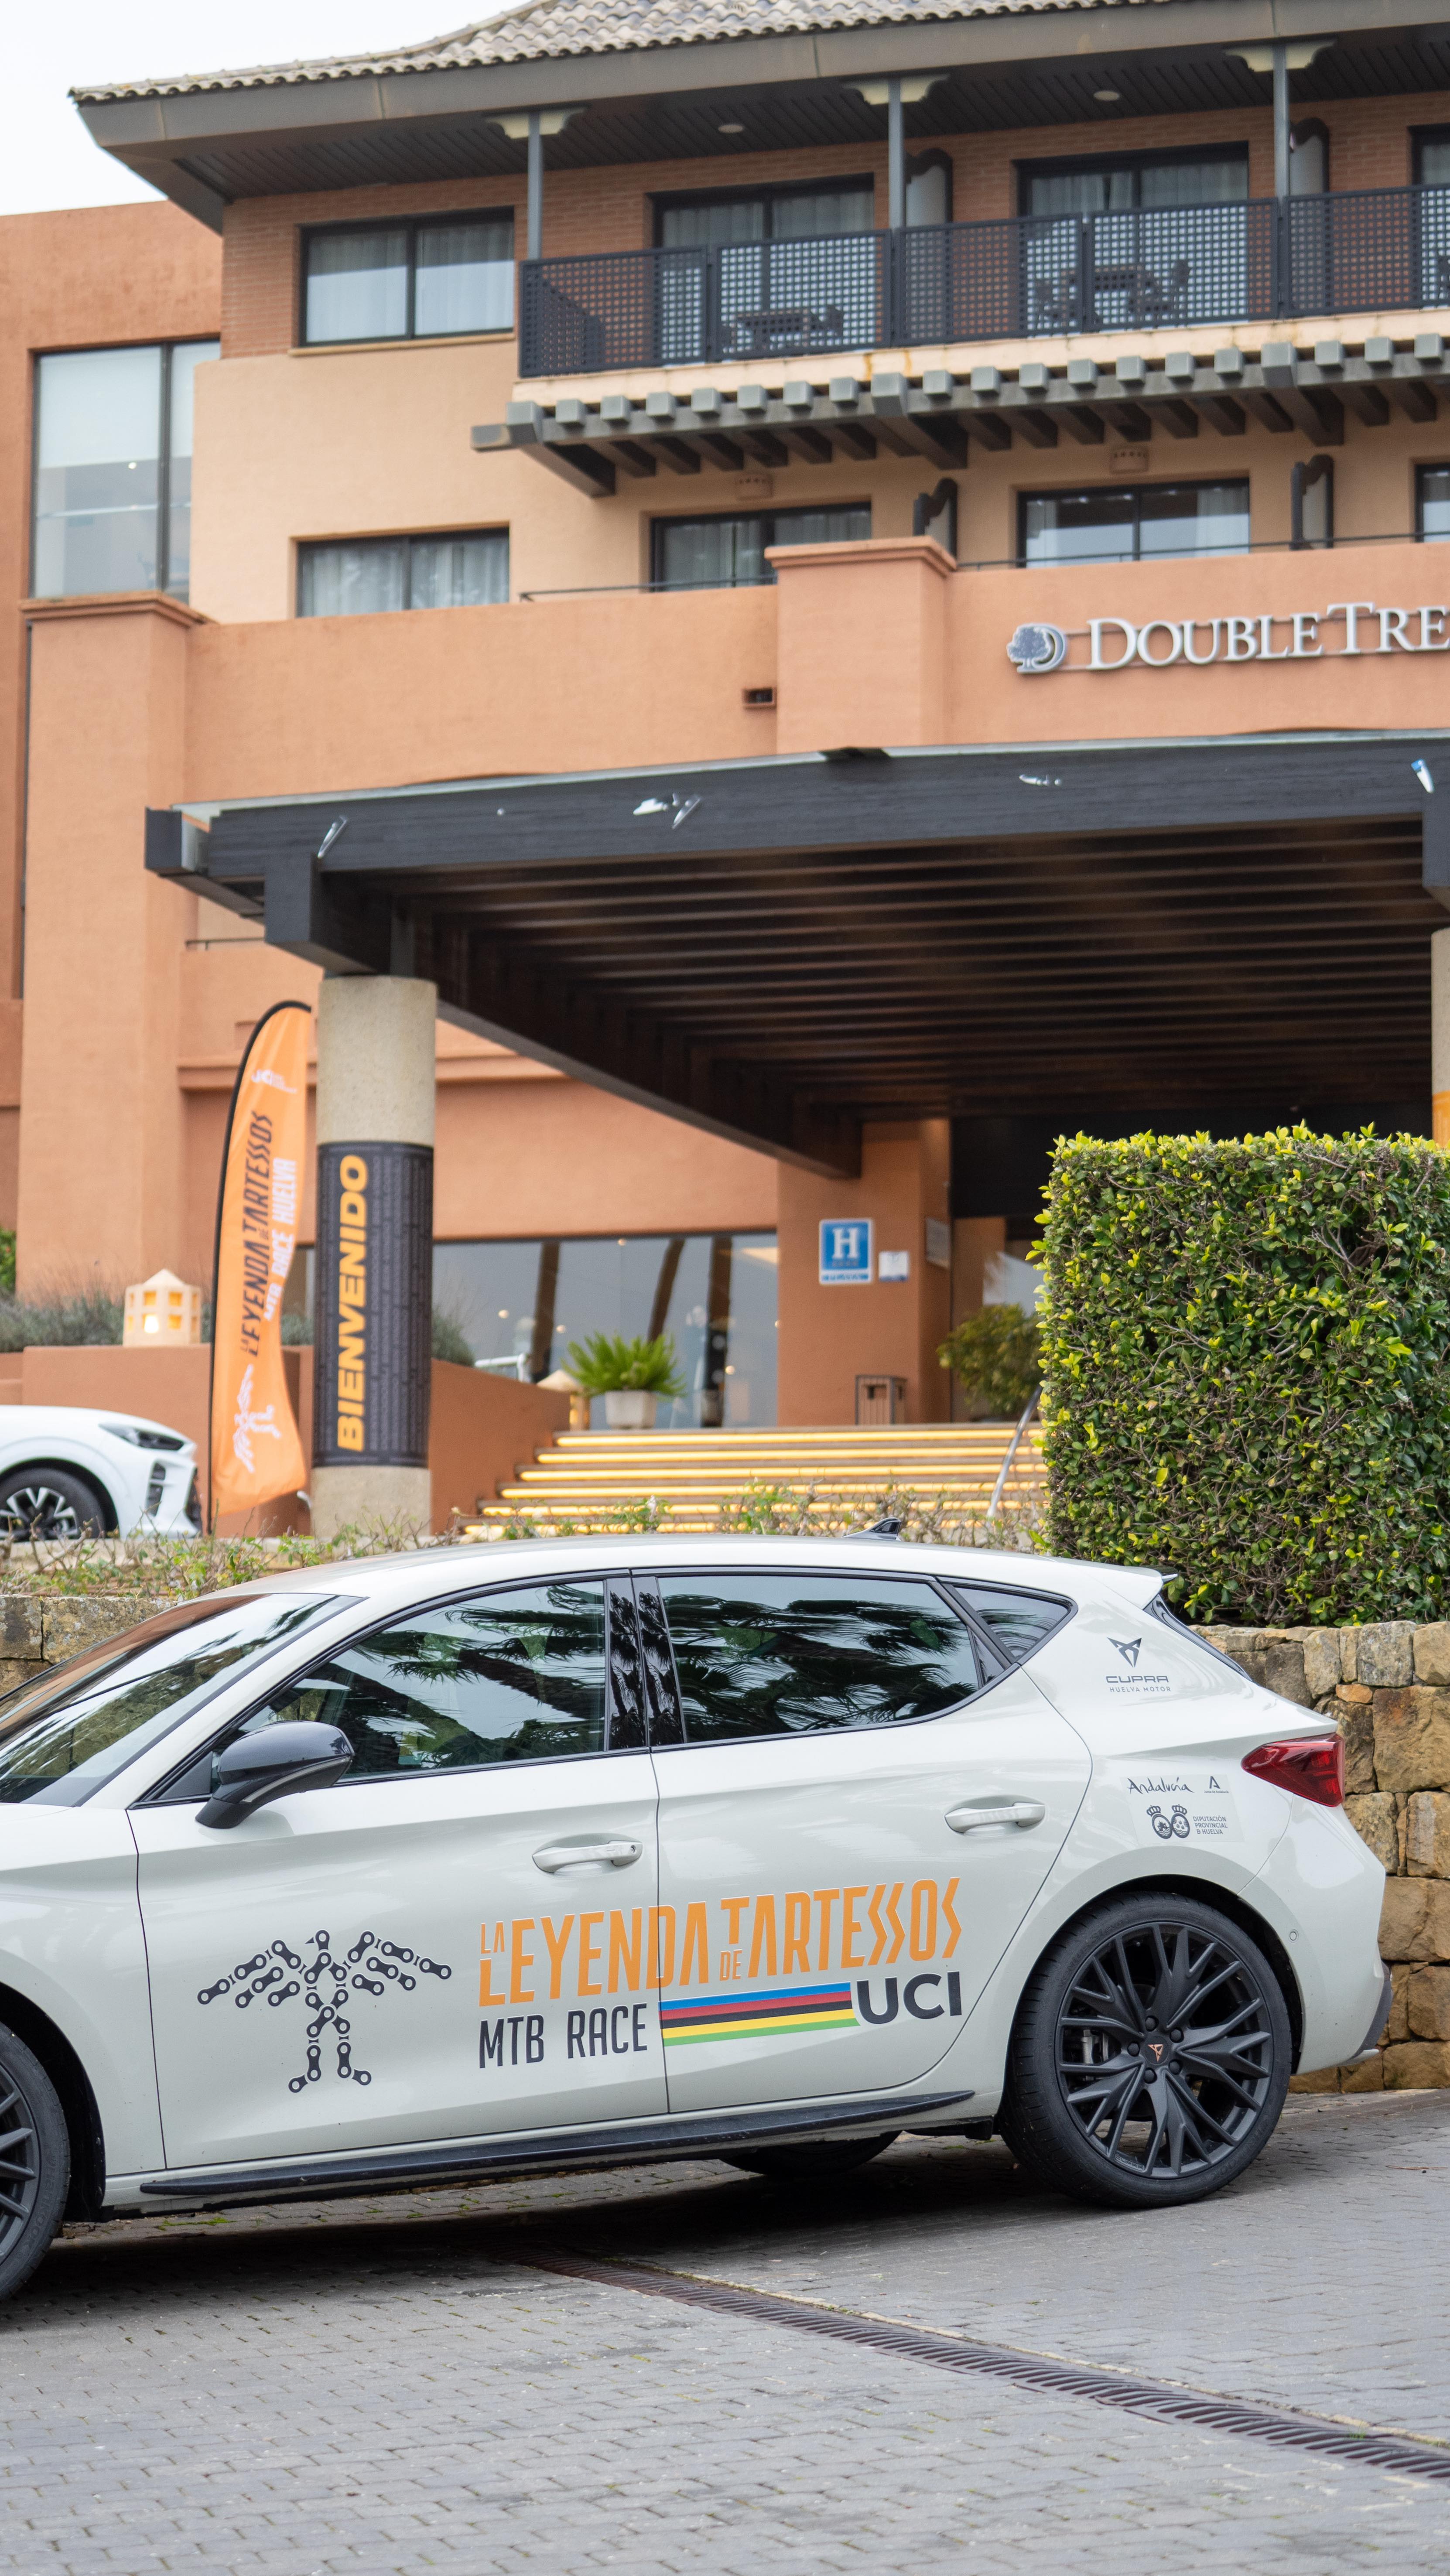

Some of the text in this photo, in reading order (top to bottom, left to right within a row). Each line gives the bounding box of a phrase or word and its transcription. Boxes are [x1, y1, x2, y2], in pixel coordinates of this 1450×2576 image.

[272, 1157, 297, 1225] HUELVA
[832, 1227, 859, 1259] H
[338, 1155, 368, 1452] BIENVENIDO
[1105, 1675, 1169, 1684] CUPRA
[1127, 1776, 1194, 1794] Andalucía
[479, 1876, 962, 2007] LA LEYENDA DE TARTESSOS
[856, 1970, 962, 2025] UCI
[479, 2003, 648, 2069] MTB RACE
